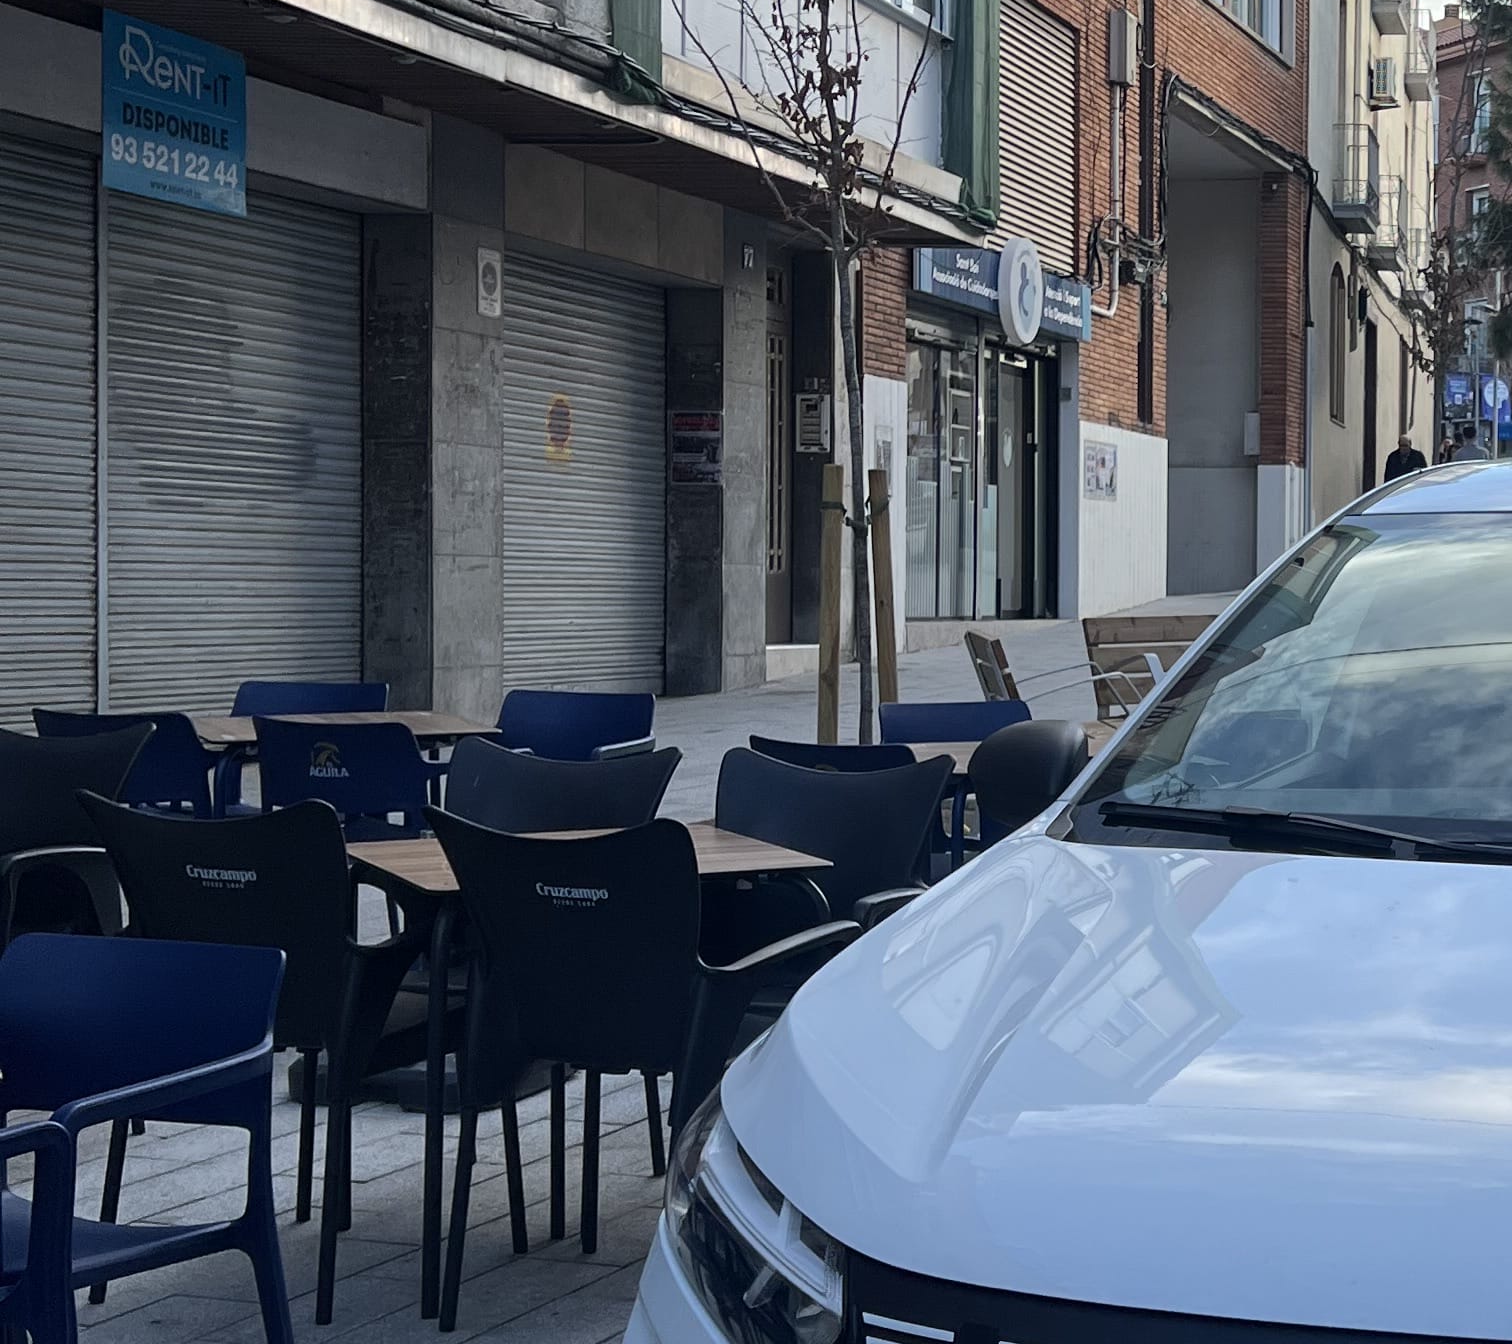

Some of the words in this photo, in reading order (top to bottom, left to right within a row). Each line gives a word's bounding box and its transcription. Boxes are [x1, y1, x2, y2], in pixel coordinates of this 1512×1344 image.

[122, 102, 230, 151] DISPONIBLE
[111, 133, 138, 165] 93
[213, 159, 239, 189] 44
[185, 863, 258, 883] Cruzcampo
[534, 881, 610, 902] Cruzcampo
